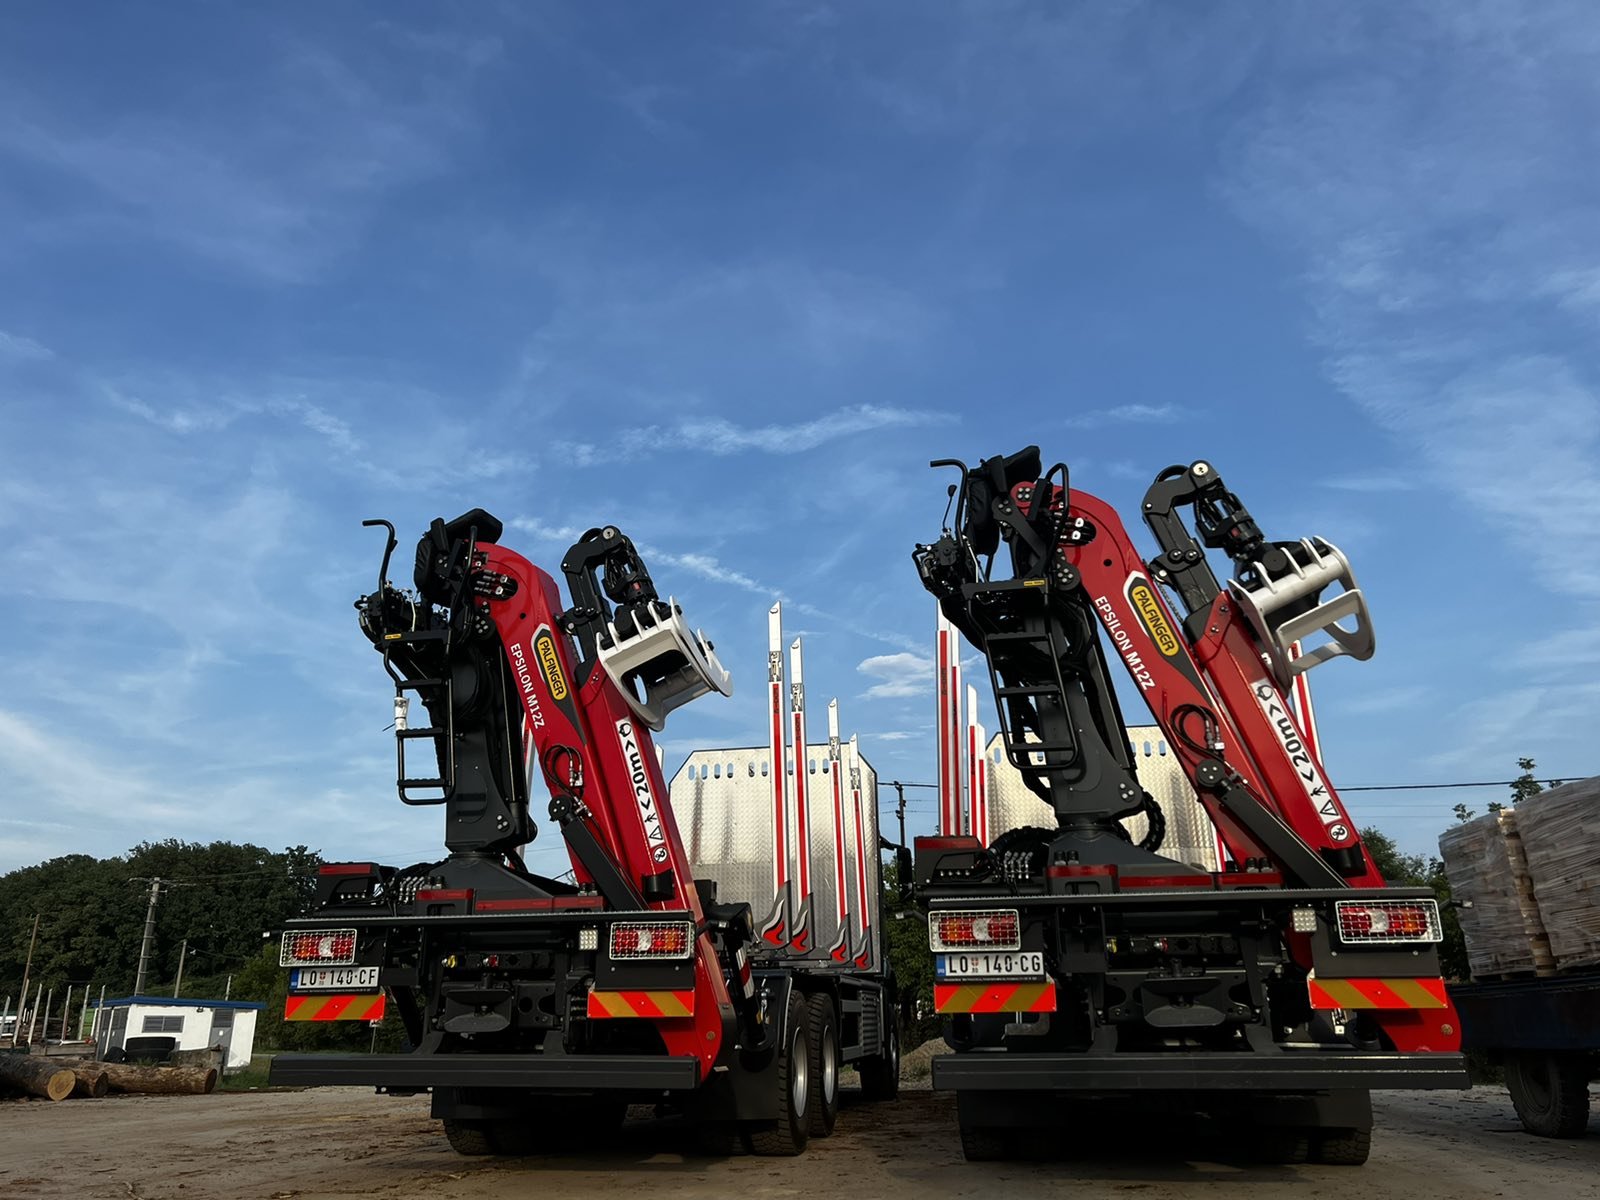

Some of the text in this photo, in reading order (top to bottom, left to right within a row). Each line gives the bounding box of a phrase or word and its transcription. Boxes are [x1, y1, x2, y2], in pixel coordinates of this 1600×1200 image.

[1094, 596, 1156, 690] EPSILON M12Z
[1135, 589, 1175, 652] PALFINGER
[510, 642, 545, 729] EPSILON M12Z
[540, 640, 565, 697] PALFINGER
[300, 970, 318, 986] LO
[948, 955, 969, 974] LO
